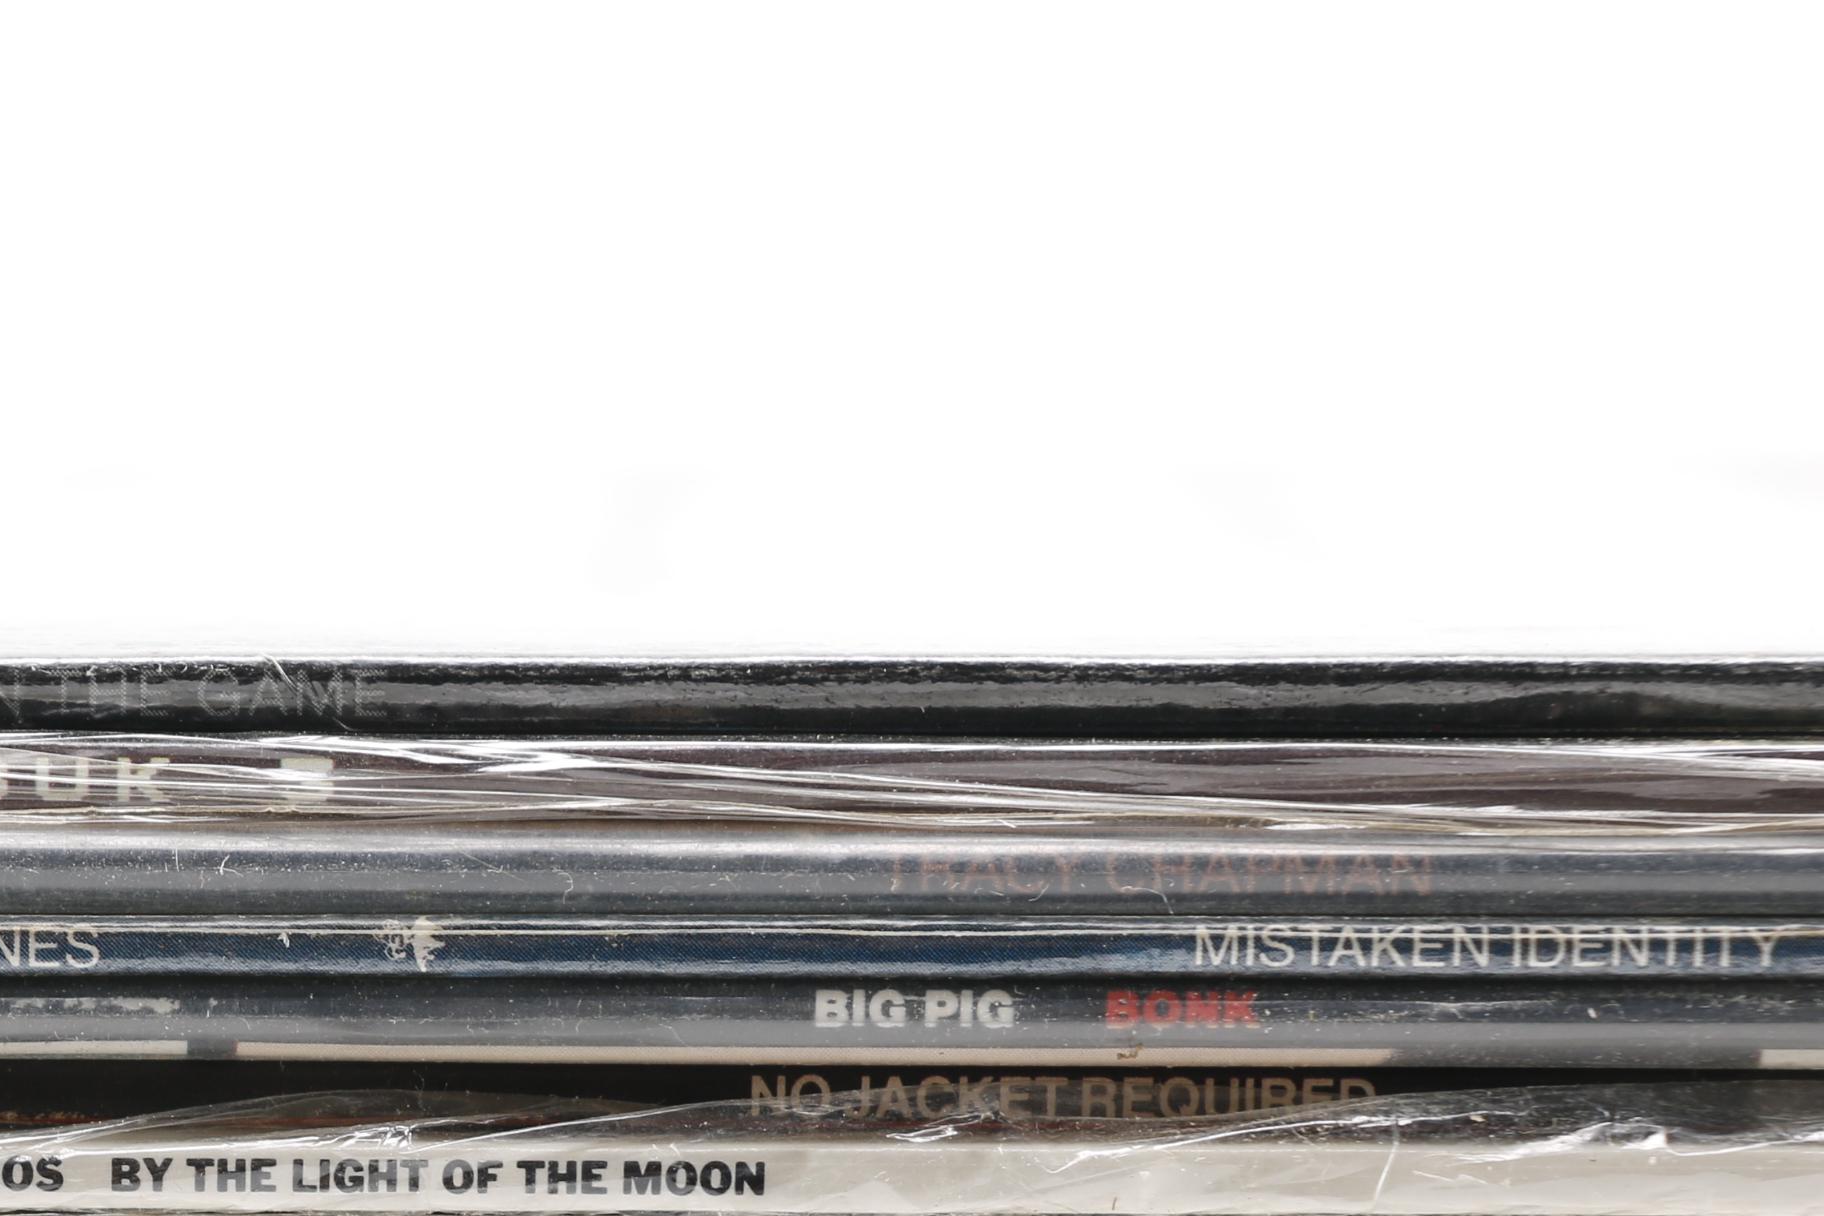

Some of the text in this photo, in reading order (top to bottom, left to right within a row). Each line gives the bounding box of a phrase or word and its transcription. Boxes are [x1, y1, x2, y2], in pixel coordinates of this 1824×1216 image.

[56, 668, 170, 718] THE
[200, 668, 388, 718] GAME
[882, 847, 1436, 898] TRACY CHAPMAN
[1194, 925, 1782, 968] MISTAKEN IDENTITY
[813, 989, 1015, 1029] BIG PIG
[1105, 990, 1260, 1029] BONK
[750, 1073, 1377, 1119] NO JACKET REQUIRED
[110, 1158, 766, 1196] BY THE LIGHT OF THE MOON
